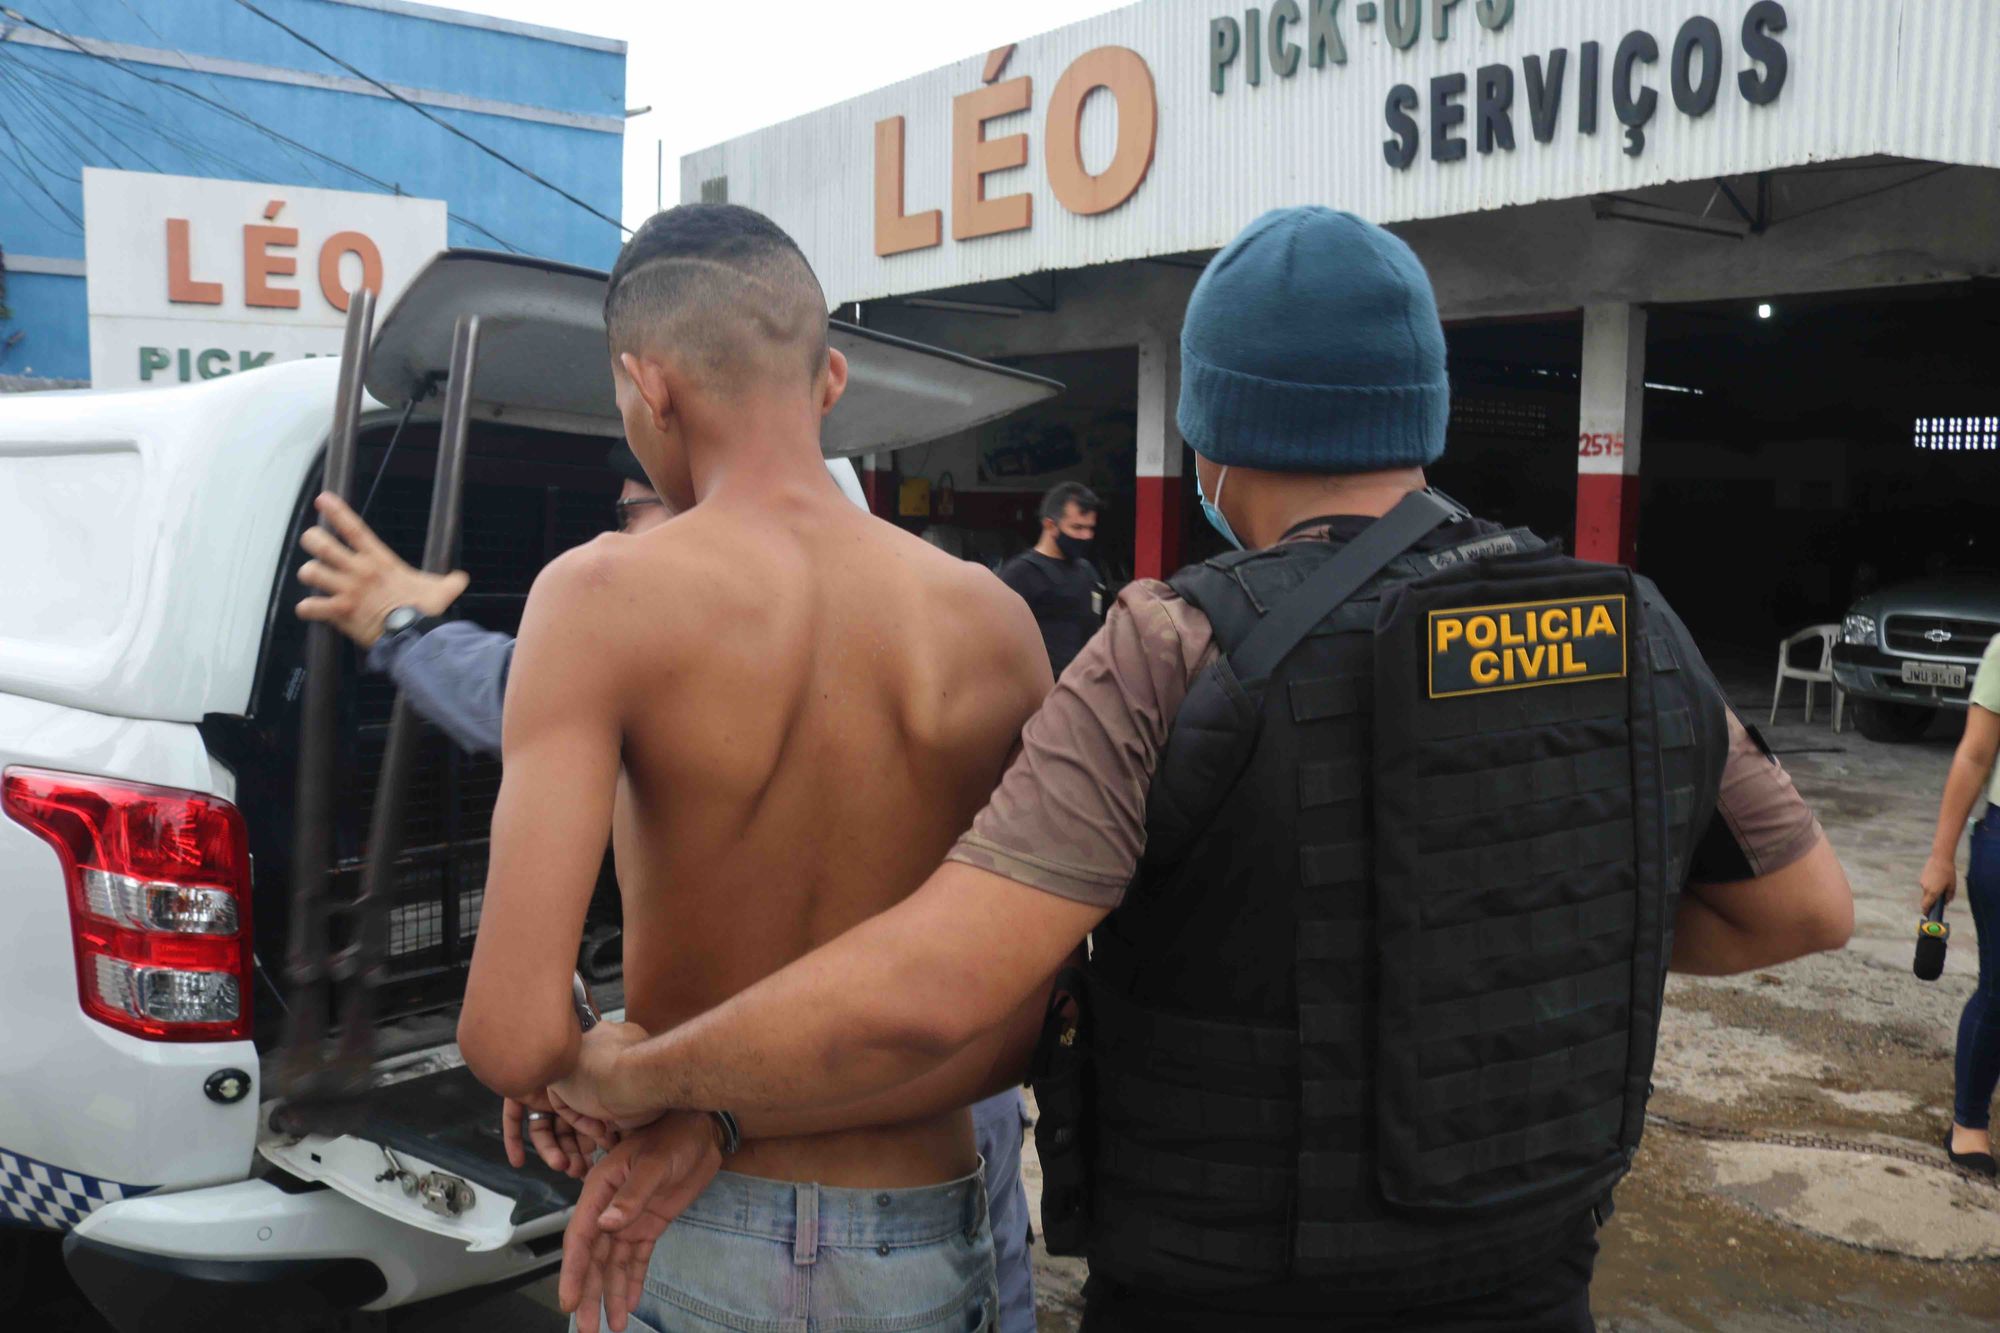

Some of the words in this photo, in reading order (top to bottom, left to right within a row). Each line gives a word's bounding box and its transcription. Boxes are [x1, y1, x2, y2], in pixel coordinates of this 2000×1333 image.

[1383, 0, 1788, 170] SERVIÇOS
[875, 43, 1158, 257] LÉO
[166, 201, 383, 312] LÉO
[1437, 604, 1617, 653] POLICIA
[1470, 642, 1587, 684] CIVIL
